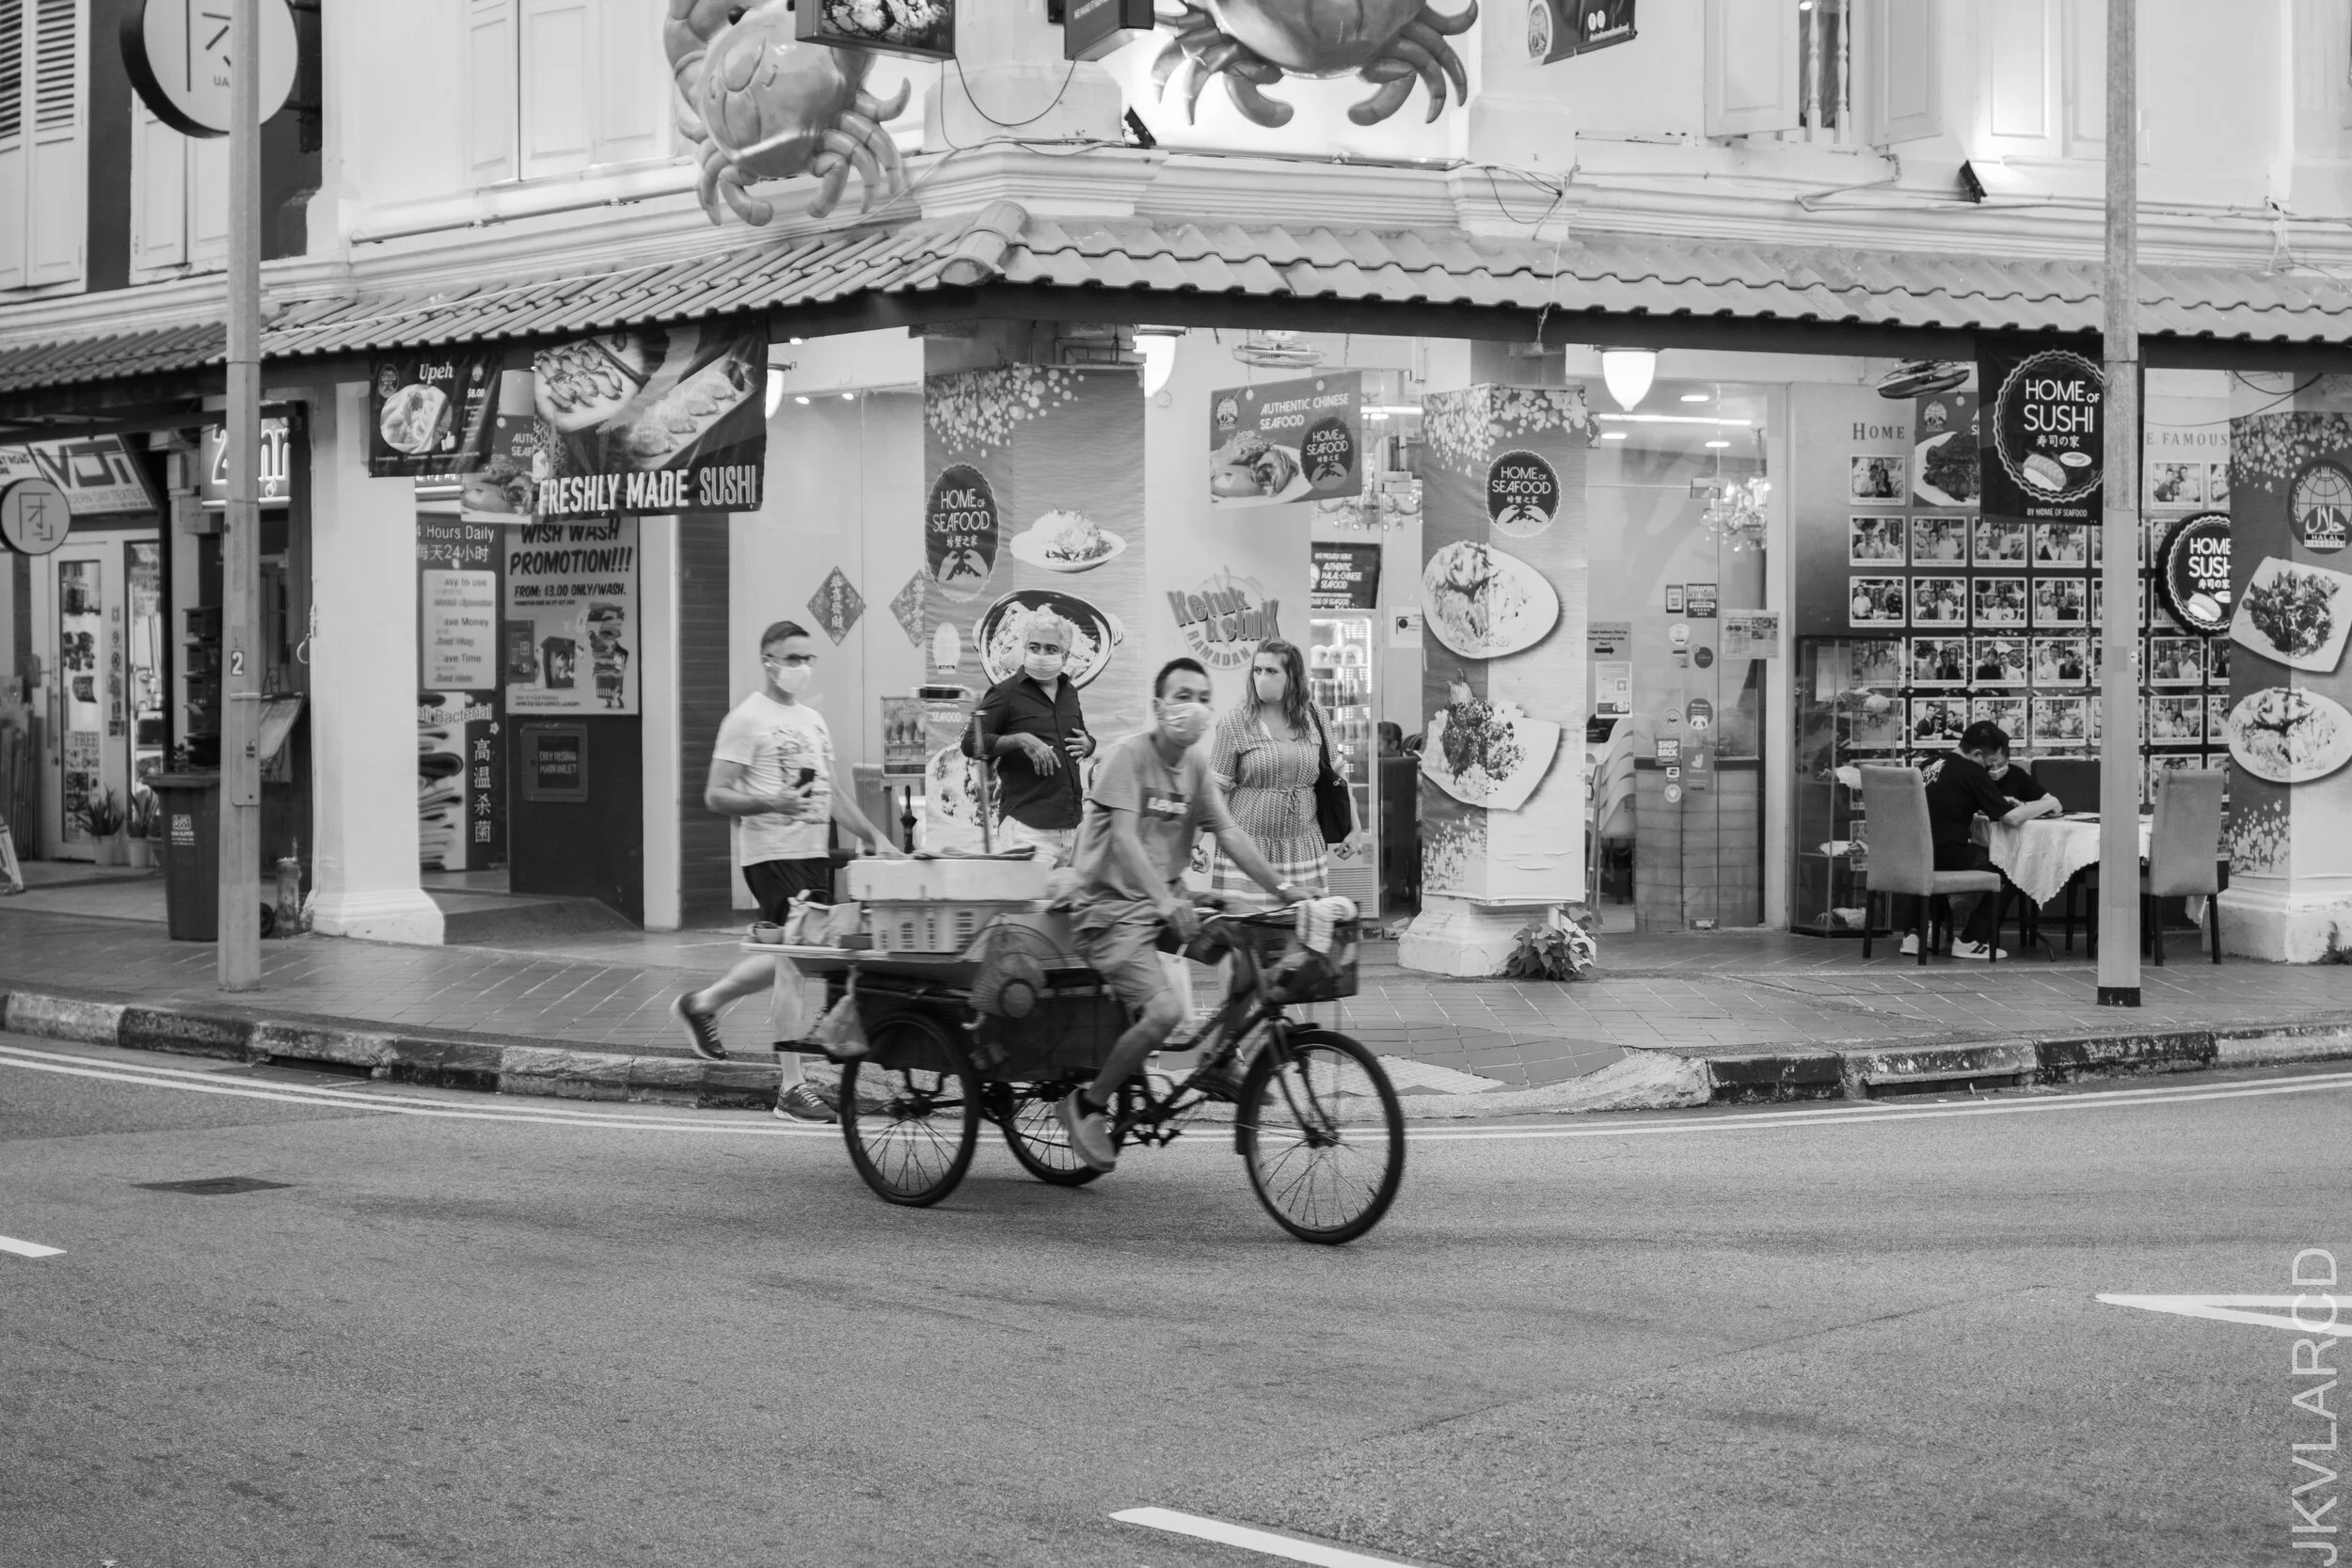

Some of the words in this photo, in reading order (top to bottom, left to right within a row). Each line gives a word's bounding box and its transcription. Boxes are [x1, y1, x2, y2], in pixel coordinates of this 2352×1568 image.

[419, 361, 453, 385] Upeh
[2026, 378, 2086, 402] HOME
[2087, 392, 2100, 404] OF
[1261, 398, 1311, 416] AUTHENTIC
[1312, 392, 1350, 409] CHINESE
[1259, 415, 1304, 431] SEAFOOD
[2023, 404, 2094, 434] SUSHI
[1312, 429, 1339, 443] HOME
[1851, 421, 1905, 441] HOME
[2163, 432, 2228, 446] FAMOUS
[1306, 440, 1349, 456] SEAFOOD
[1501, 466, 1538, 480] HOME
[538, 472, 620, 516] FRESHLY
[627, 468, 690, 509] MADE
[699, 464, 756, 507] SUSHI
[1491, 480, 1552, 495] SEAFOOD
[940, 487, 977, 510] HOME
[932, 511, 991, 533] SEAFOOD
[2026, 508, 2035, 516] BY
[2036, 508, 2054, 517] HOME
[2055, 509, 2062, 517] OF
[2063, 508, 2089, 517] SEAFOOD
[426, 526, 461, 540] Hours
[465, 524, 495, 544] Daily
[520, 523, 564, 545] WISH
[568, 518, 622, 543] WASH
[2189, 537, 2232, 555] HOME
[509, 546, 633, 577] PROMOTION!!!
[2187, 556, 2232, 578] SUSH
[514, 585, 541, 598] FROM:
[544, 583, 569, 597] $3.00
[461, 617, 489, 627] Money
[1186, 629, 1251, 666] RAMADAN
[230, 651, 244, 675] 2
[461, 653, 483, 663] Time
[539, 751, 553, 762] DRY
